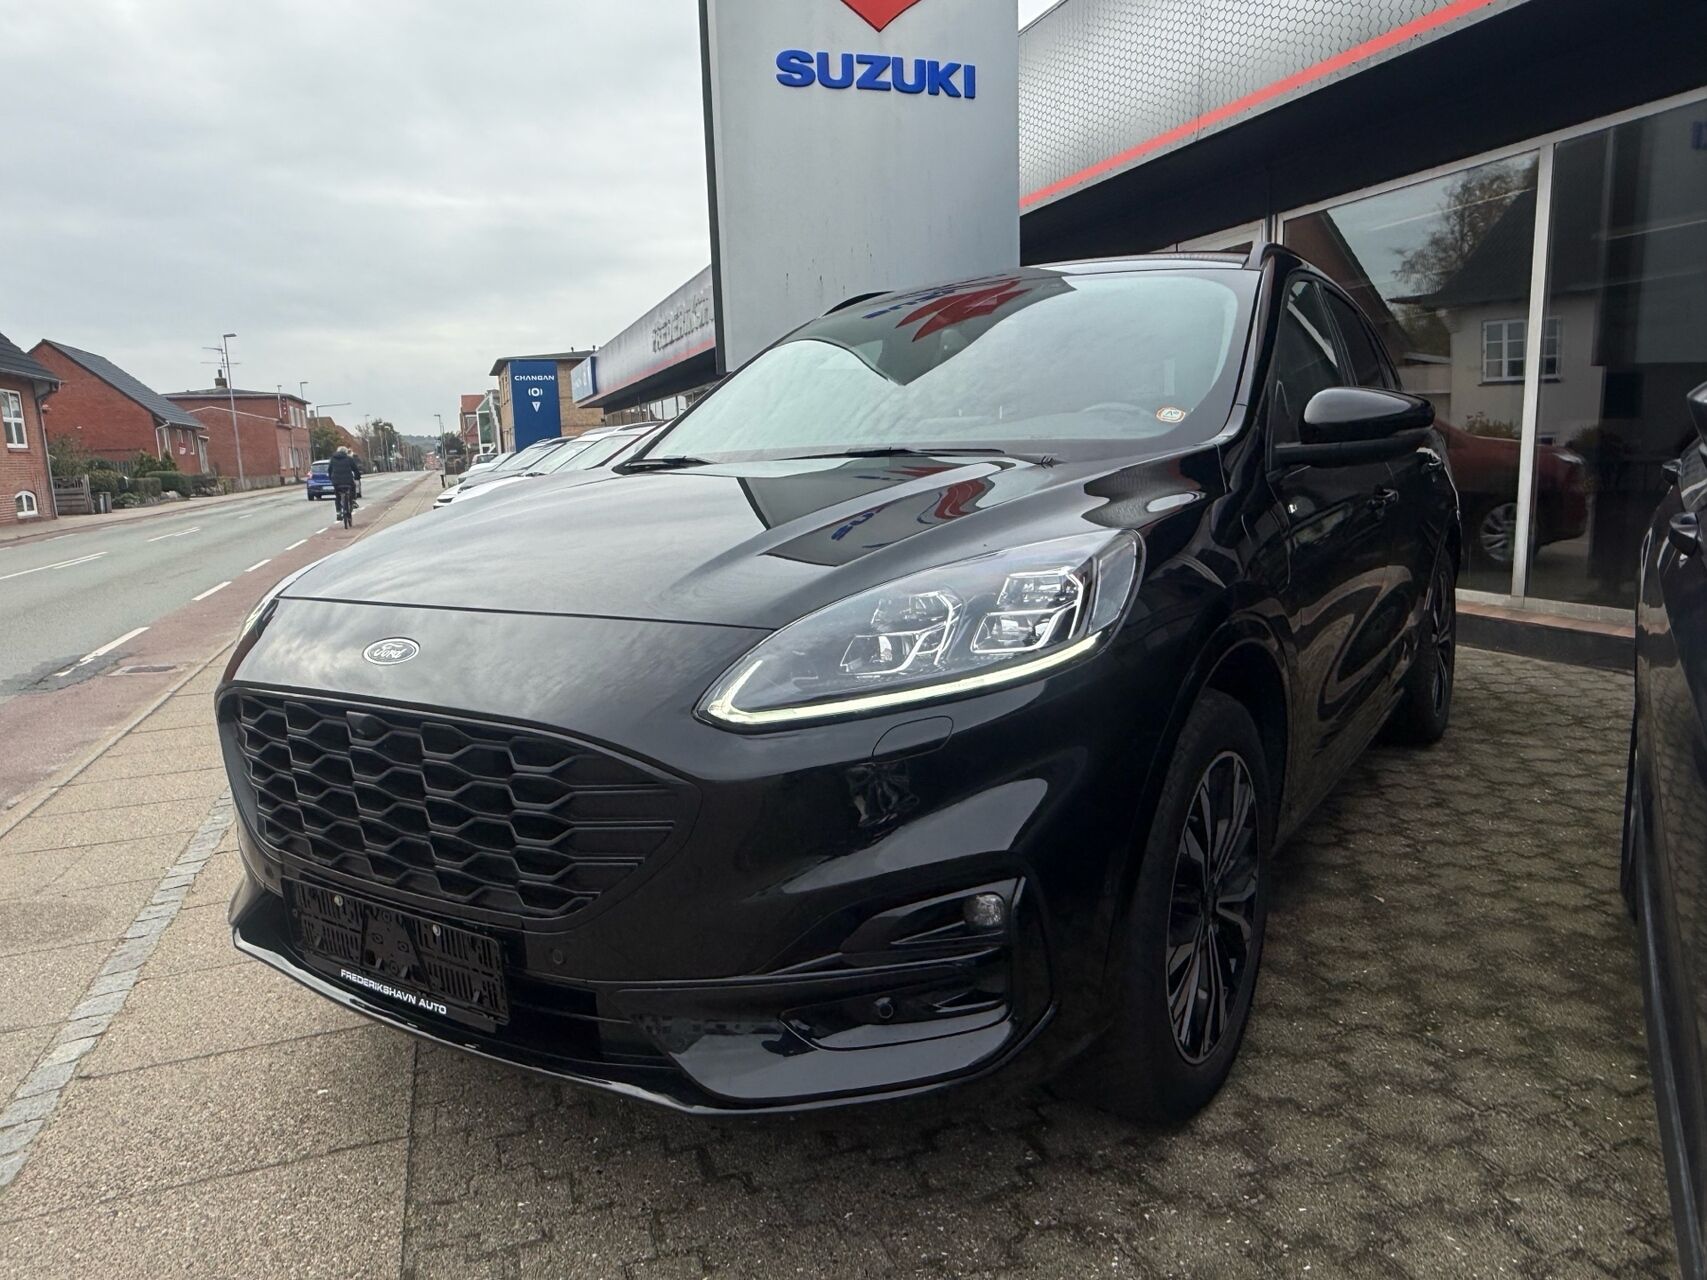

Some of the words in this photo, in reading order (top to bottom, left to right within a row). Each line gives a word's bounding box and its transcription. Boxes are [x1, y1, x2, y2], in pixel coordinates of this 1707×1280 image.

[776, 50, 976, 99] SUZUKI
[340, 968, 417, 1005] FREDERIKSHAVN
[418, 998, 447, 1015] AUTO
